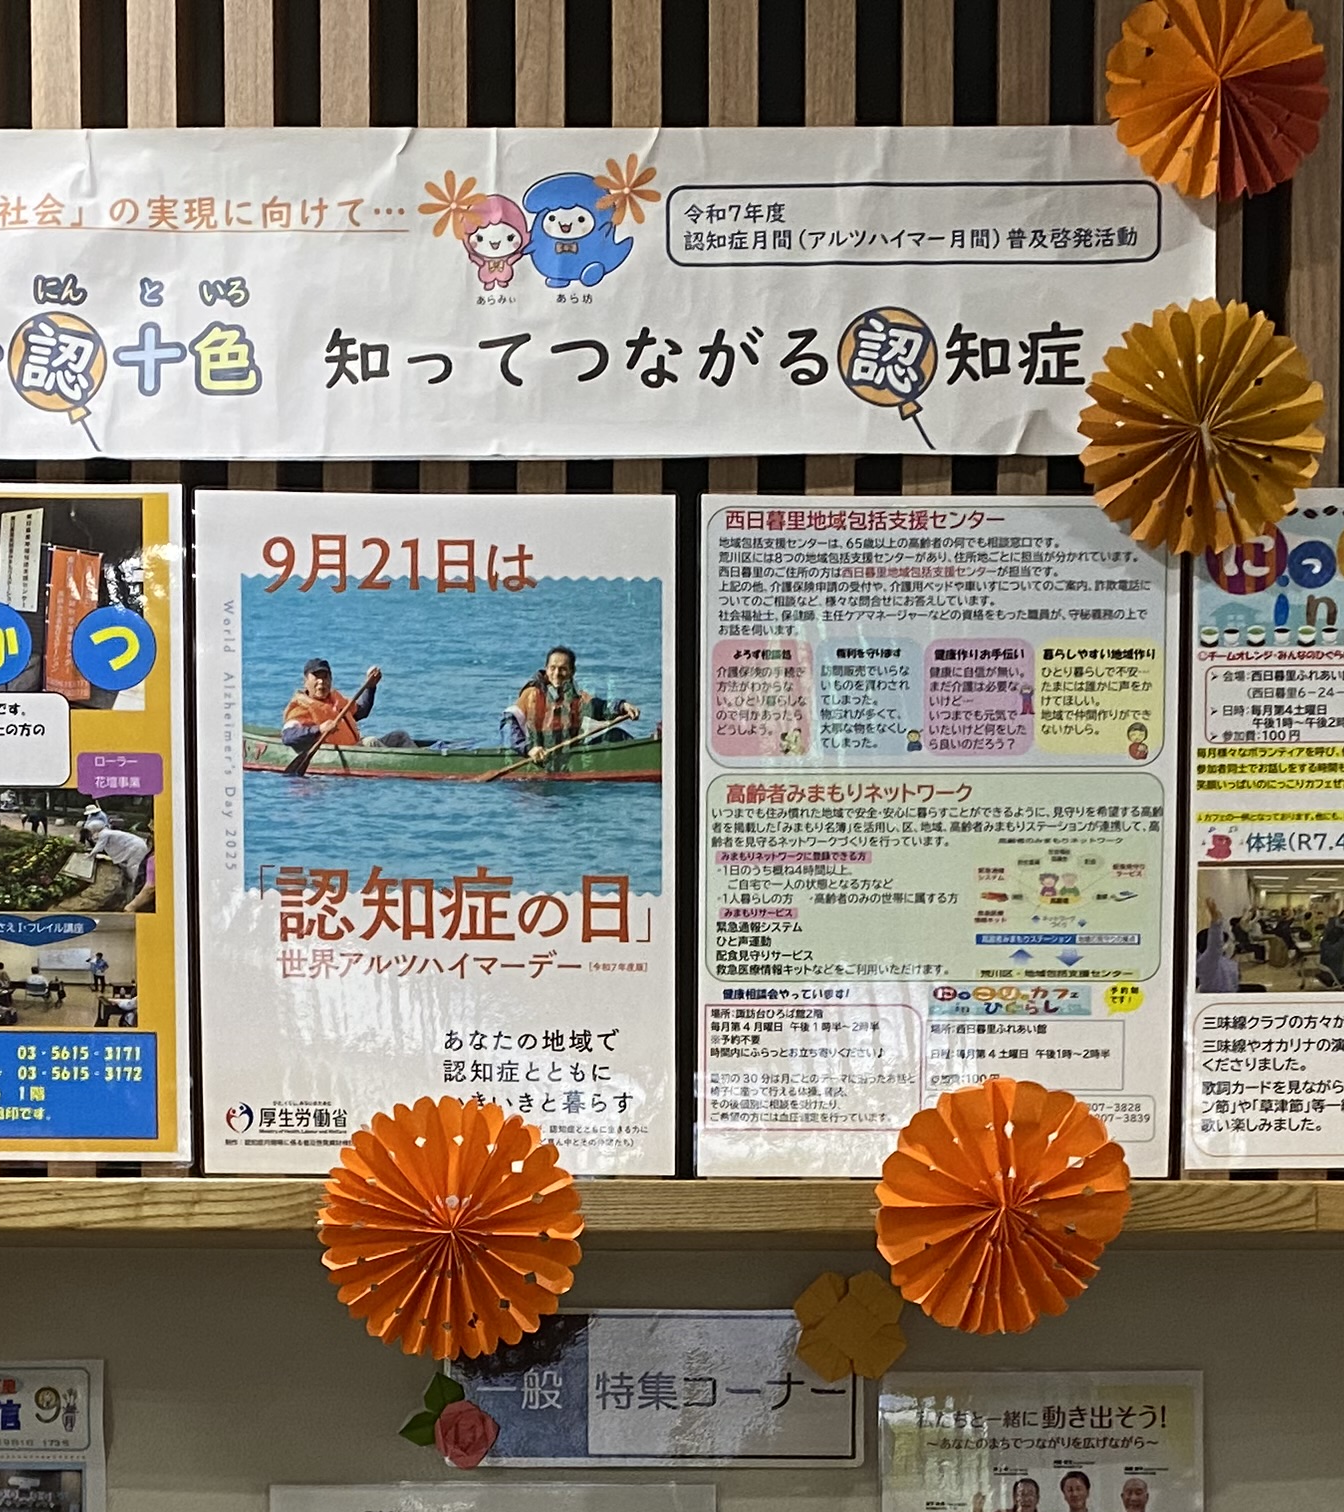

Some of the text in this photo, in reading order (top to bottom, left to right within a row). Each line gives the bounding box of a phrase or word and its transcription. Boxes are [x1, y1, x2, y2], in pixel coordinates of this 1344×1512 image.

[682, 202, 787, 226] 令和7年度
[31, 275, 88, 308] にん
[140, 279, 165, 305] と
[197, 278, 252, 306] いろ
[324, 310, 1087, 408] 知ってつながる認知症
[725, 510, 1005, 531] 西日暮里地域包括支援センター
[261, 533, 539, 594] 9月21日は
[222, 600, 234, 655] World
[1041, 694, 1102, 707] けてほしい。
[929, 709, 1018, 721] いつまでも元気で
[1041, 709, 1151, 722] 地域で仲間作りができ
[929, 723, 1026, 736] いたいけど何をした
[1041, 723, 1101, 736] ないかしら。
[94, 756, 138, 767] ローラー
[224, 786, 237, 819] Day
[726, 783, 974, 804] 高齢者みまもりネットワーク
[225, 828, 237, 872] 2025
[259, 864, 652, 943] 「認知症の日」
[716, 921, 802, 934] 緊急通報システム
[716, 936, 772, 948] ひと声運動
[276, 949, 582, 980] 世界アルツハイマーデー
[716, 949, 814, 962] 配食見守りサービス
[444, 1029, 619, 1053] あなたの地域で
[443, 1060, 611, 1083] 認知症とともに
[1202, 1057, 1309, 1072] くださりました。
[258, 1108, 348, 1129] 厚生労働省
[1201, 1117, 1324, 1132] 歌い楽しみました。
[476, 1371, 847, 1412] 一般 特集コーナー
